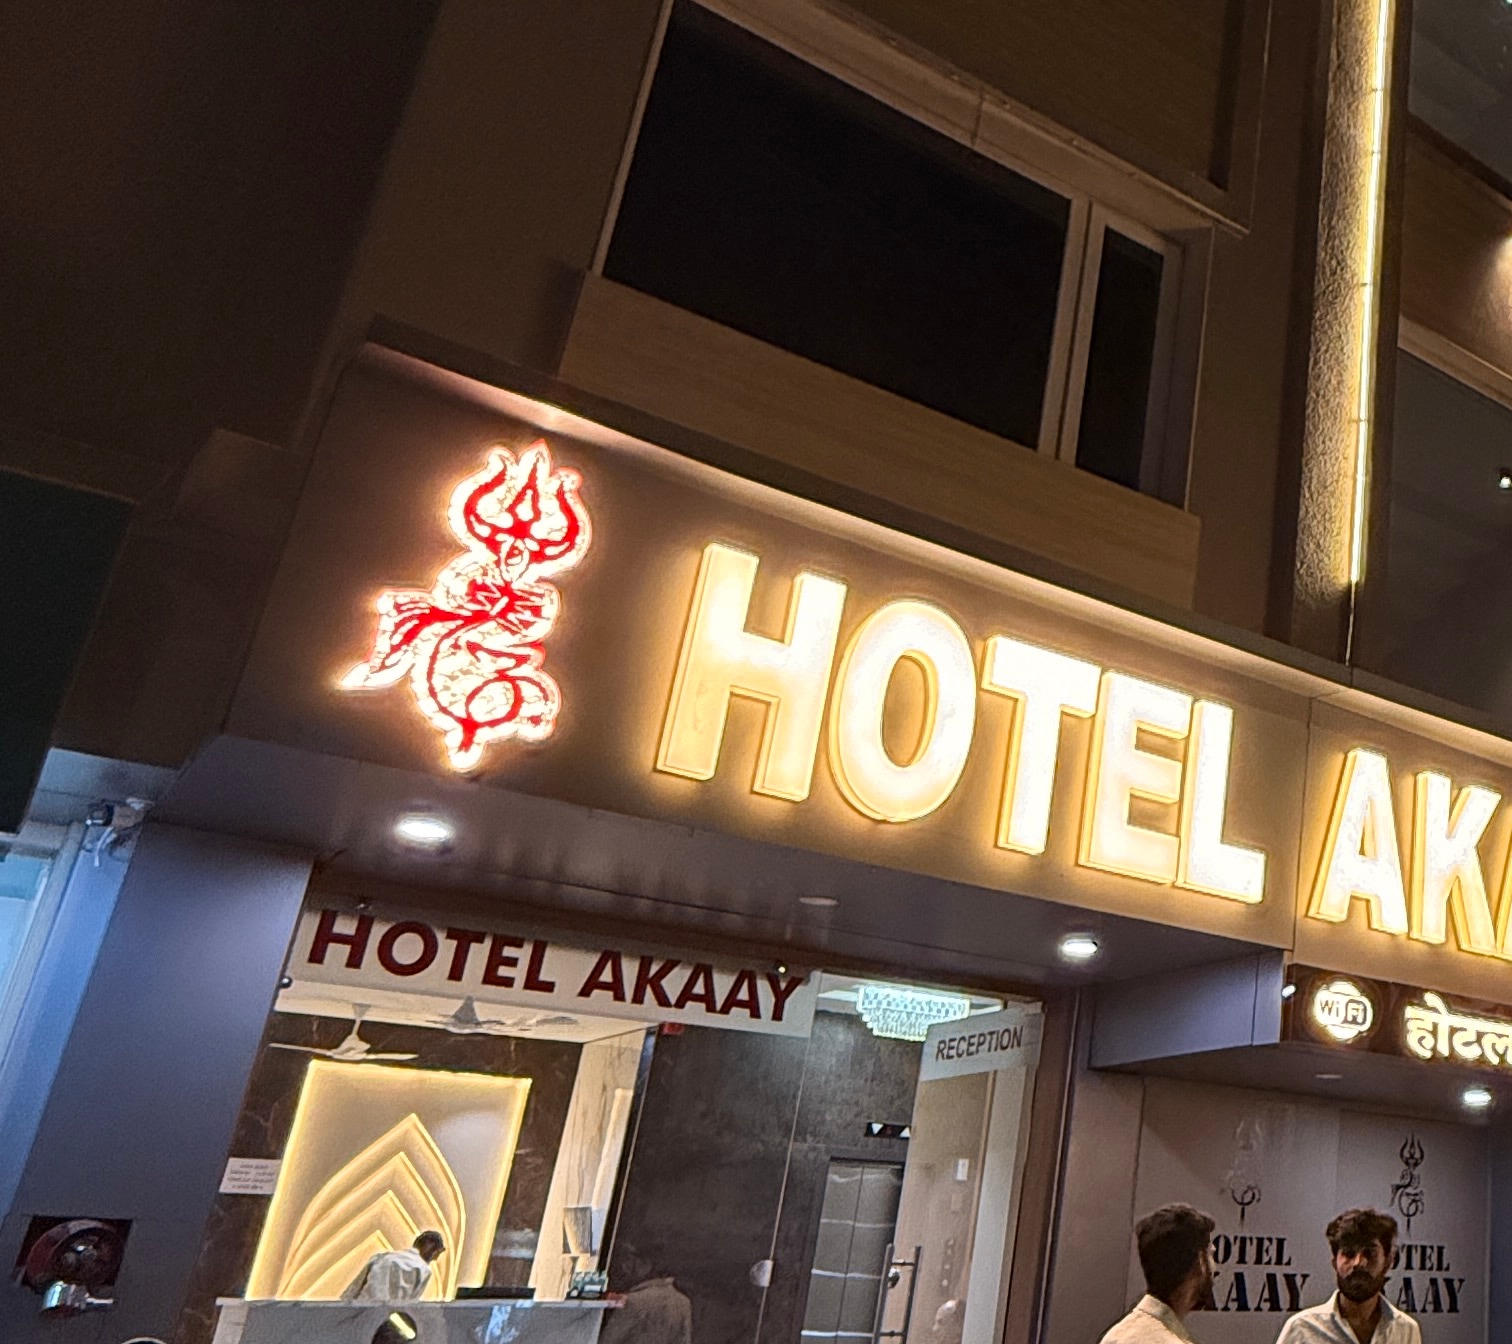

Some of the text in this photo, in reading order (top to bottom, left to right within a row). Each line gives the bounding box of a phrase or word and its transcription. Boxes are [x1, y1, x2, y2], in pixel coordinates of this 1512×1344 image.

[655, 542, 1265, 904] HOTEL
[307, 910, 803, 1022] HOTEL AKAAY
[935, 1025, 1023, 1061] RECEPTION
[1212, 1234, 1291, 1266] OTEL
[1392, 1244, 1450, 1272] TEL
